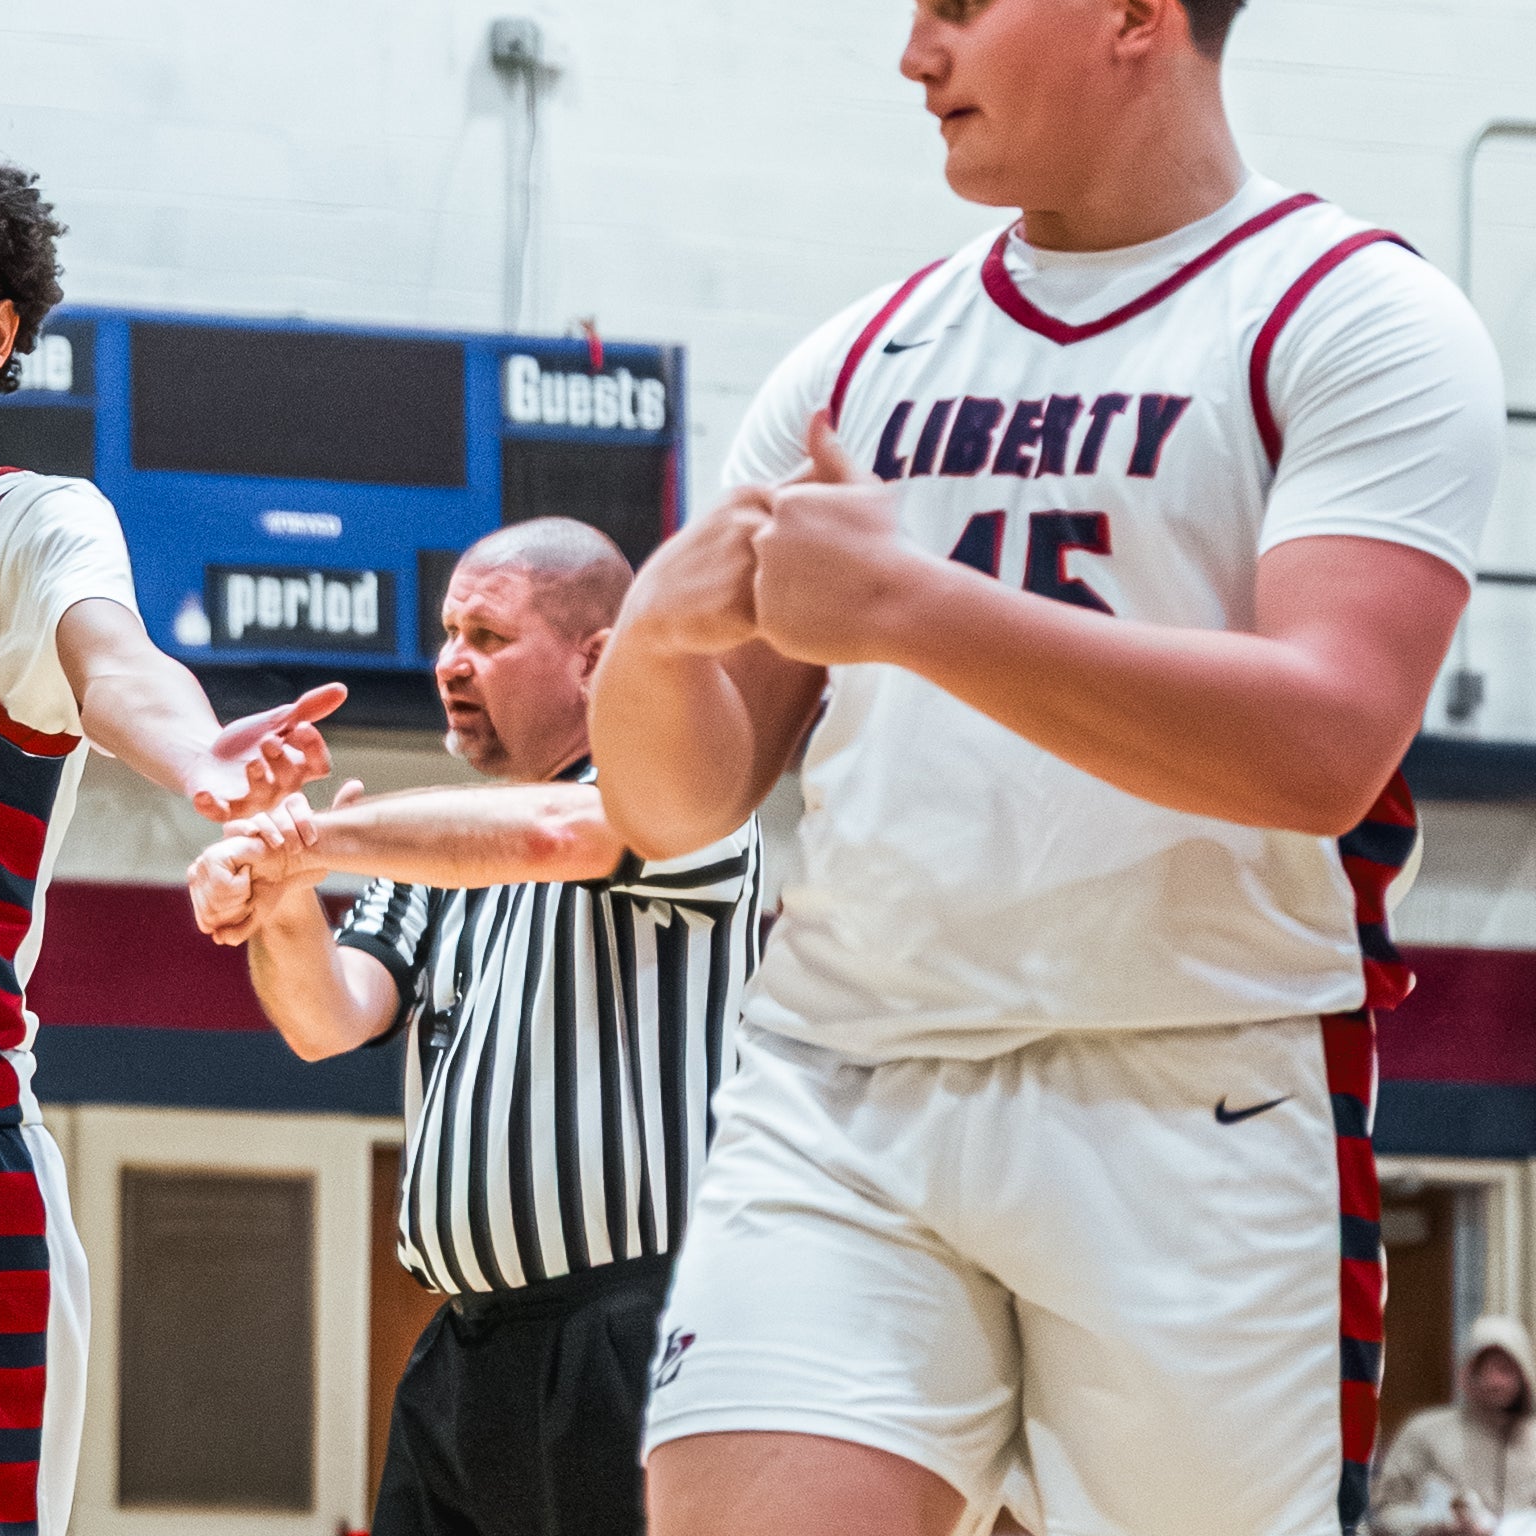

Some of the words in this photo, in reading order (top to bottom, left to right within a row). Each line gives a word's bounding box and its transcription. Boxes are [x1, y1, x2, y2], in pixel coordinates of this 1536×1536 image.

[508, 354, 665, 430] Guests
[871, 392, 1193, 483] LIBERTY
[227, 572, 378, 639] period
